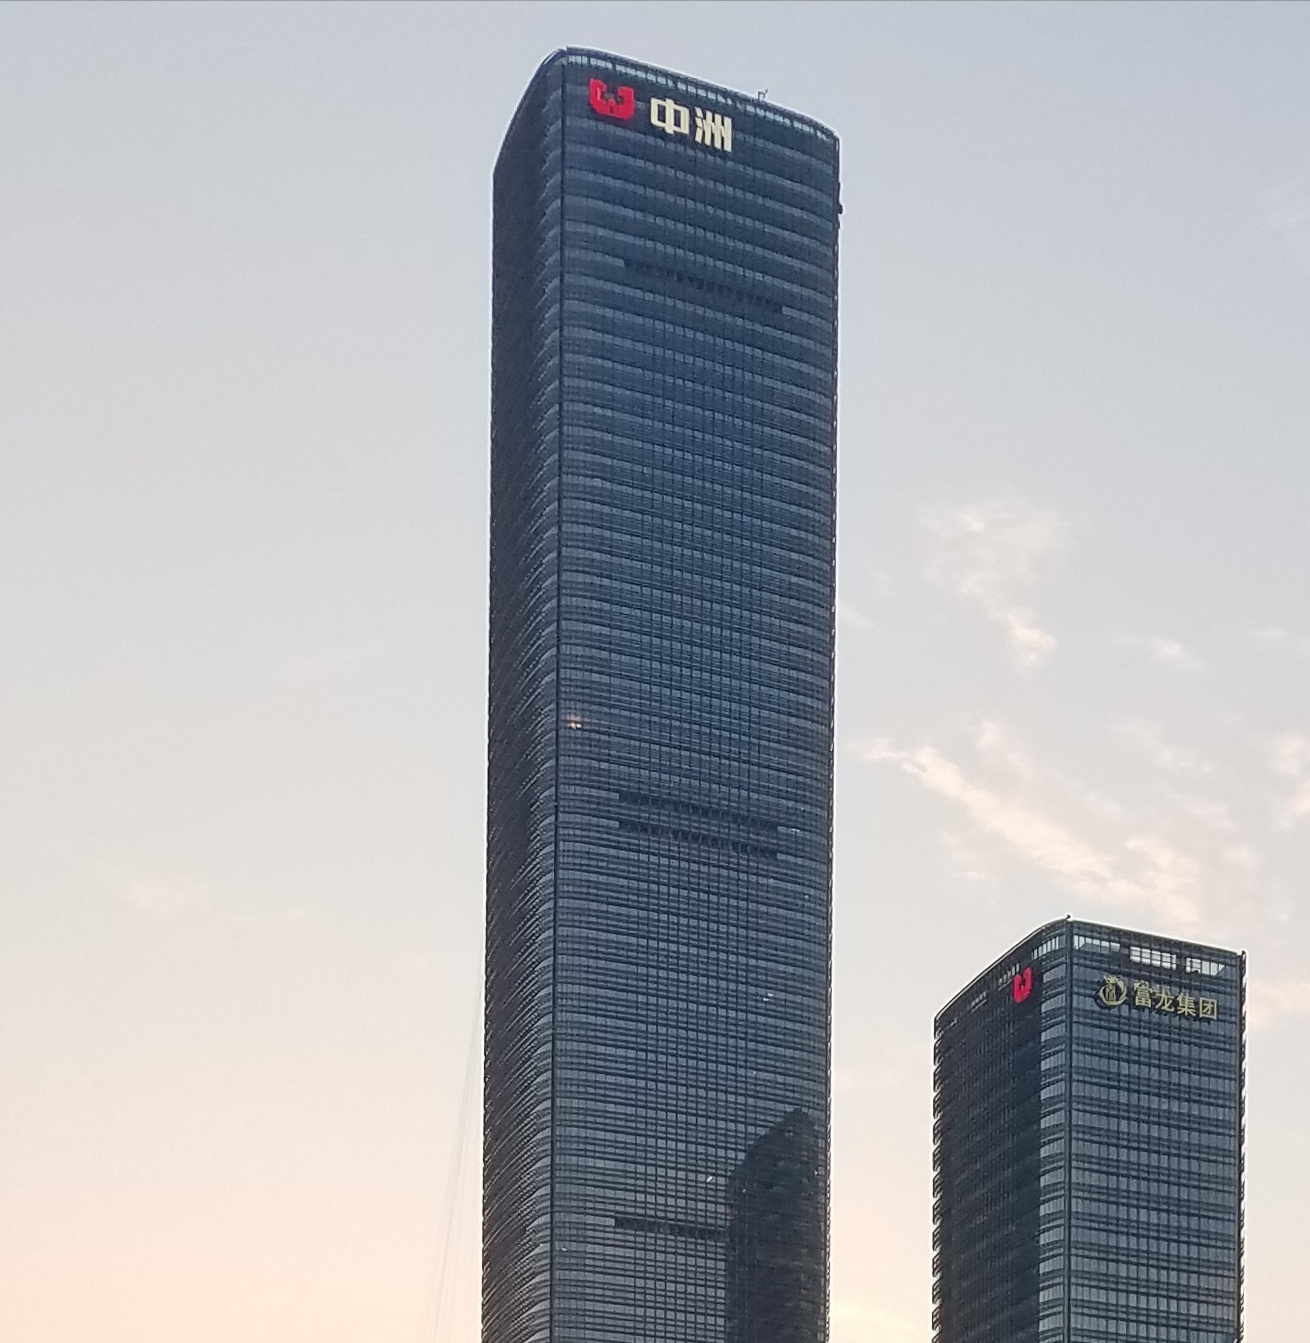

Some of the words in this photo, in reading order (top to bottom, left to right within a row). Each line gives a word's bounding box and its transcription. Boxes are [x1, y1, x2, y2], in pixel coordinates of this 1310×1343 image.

[650, 97, 732, 152] 中洲
[1133, 981, 1218, 1020] 富龙集团
